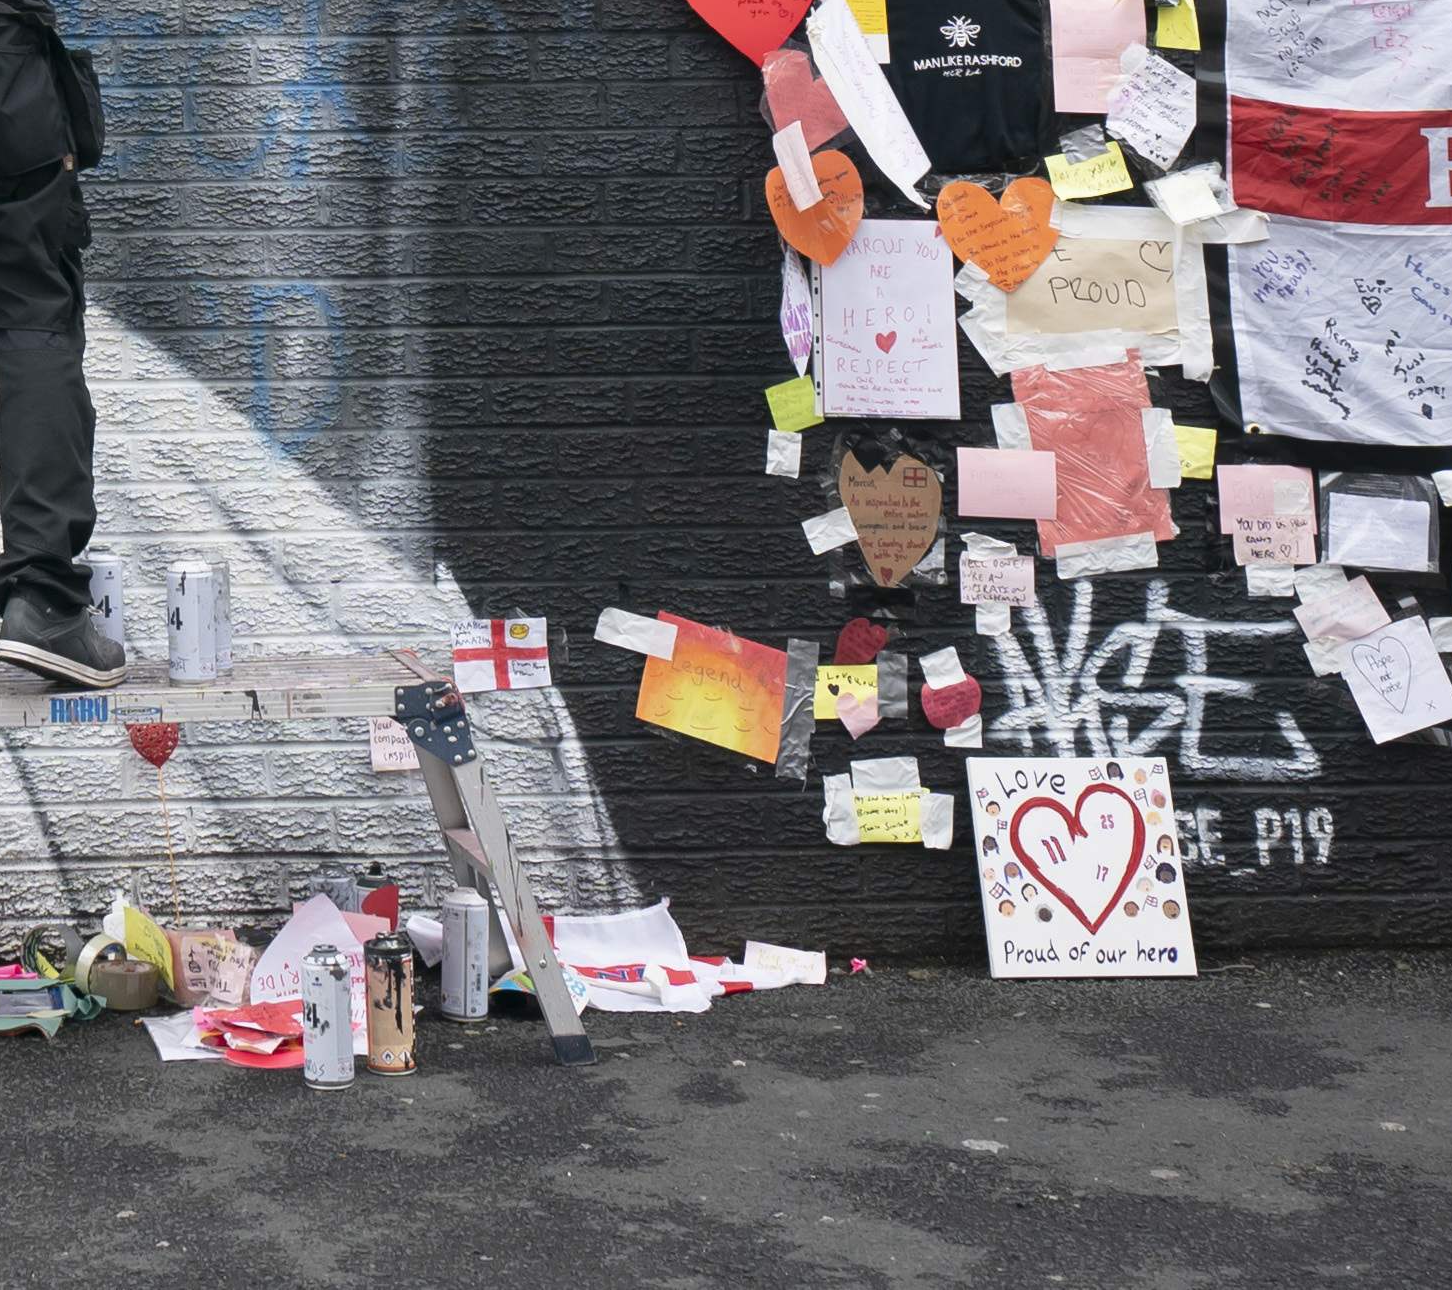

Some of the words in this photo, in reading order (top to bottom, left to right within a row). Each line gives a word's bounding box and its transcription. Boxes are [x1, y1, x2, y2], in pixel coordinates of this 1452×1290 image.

[913, 59, 941, 70] MAN
[941, 57, 963, 69] LIKE
[964, 54, 1022, 68] RASHFORD
[1049, 277, 1146, 308] PROUD
[837, 358, 928, 374] RESPECT
[1364, 653, 1396, 672] Hope
[670, 655, 746, 694] Legend
[1380, 681, 1403, 696] hate
[1000, 771, 1066, 799] Love
[1100, 814, 1114, 830] 25
[1041, 836, 1068, 865] 11
[1095, 865, 1109, 881] 17
[1004, 940, 1059, 964] Proud
[1069, 939, 1090, 962] of
[1096, 946, 1128, 964] our
[1137, 939, 1179, 964] hero
